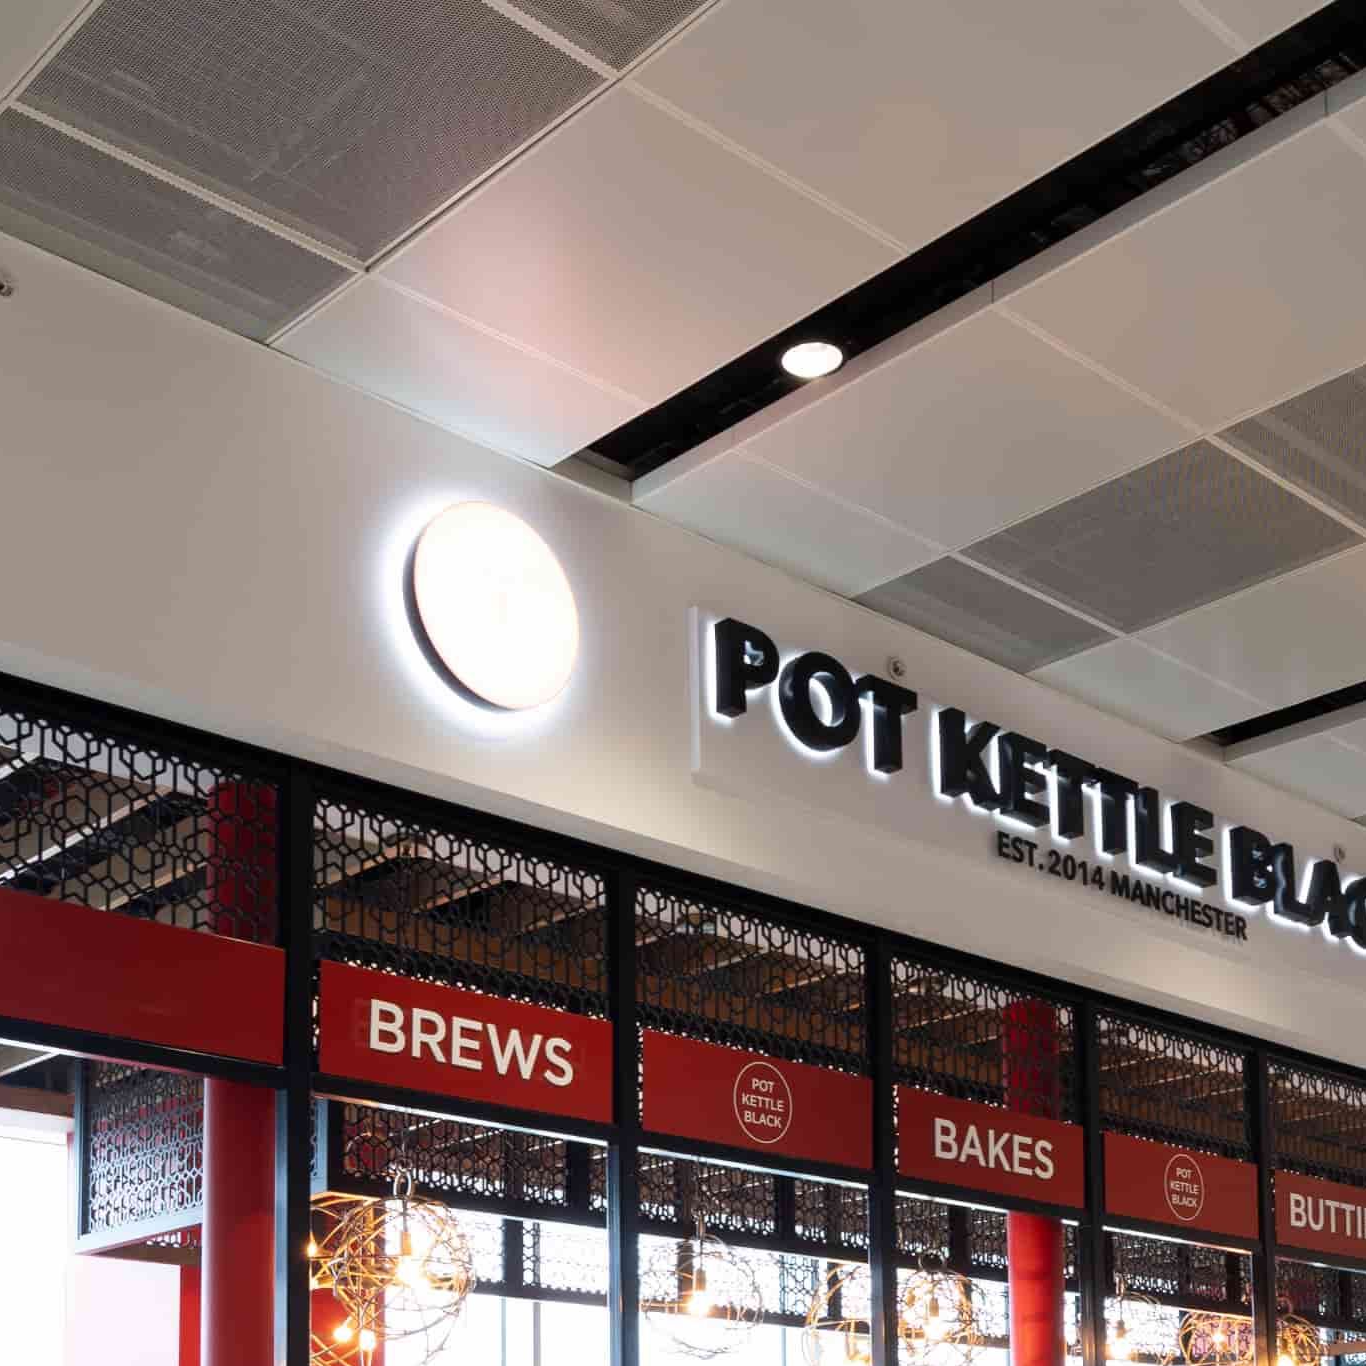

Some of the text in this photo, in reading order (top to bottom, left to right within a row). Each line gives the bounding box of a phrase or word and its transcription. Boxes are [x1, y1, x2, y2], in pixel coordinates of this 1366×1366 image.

[714, 617, 918, 775] POT
[937, 706, 1218, 889] KETTLE
[996, 830, 1248, 942] EST. 2014 MANCHESTER
[369, 998, 575, 1087] BREWS
[752, 1077, 775, 1093] POT
[741, 1093, 785, 1112] KETTLE
[743, 1110, 782, 1129] BLACK
[934, 1117, 1056, 1180] BAKES
[1175, 1167, 1192, 1180] POT
[1170, 1180, 1201, 1195] KETTLE
[1171, 1194, 1198, 1208] BLACK
